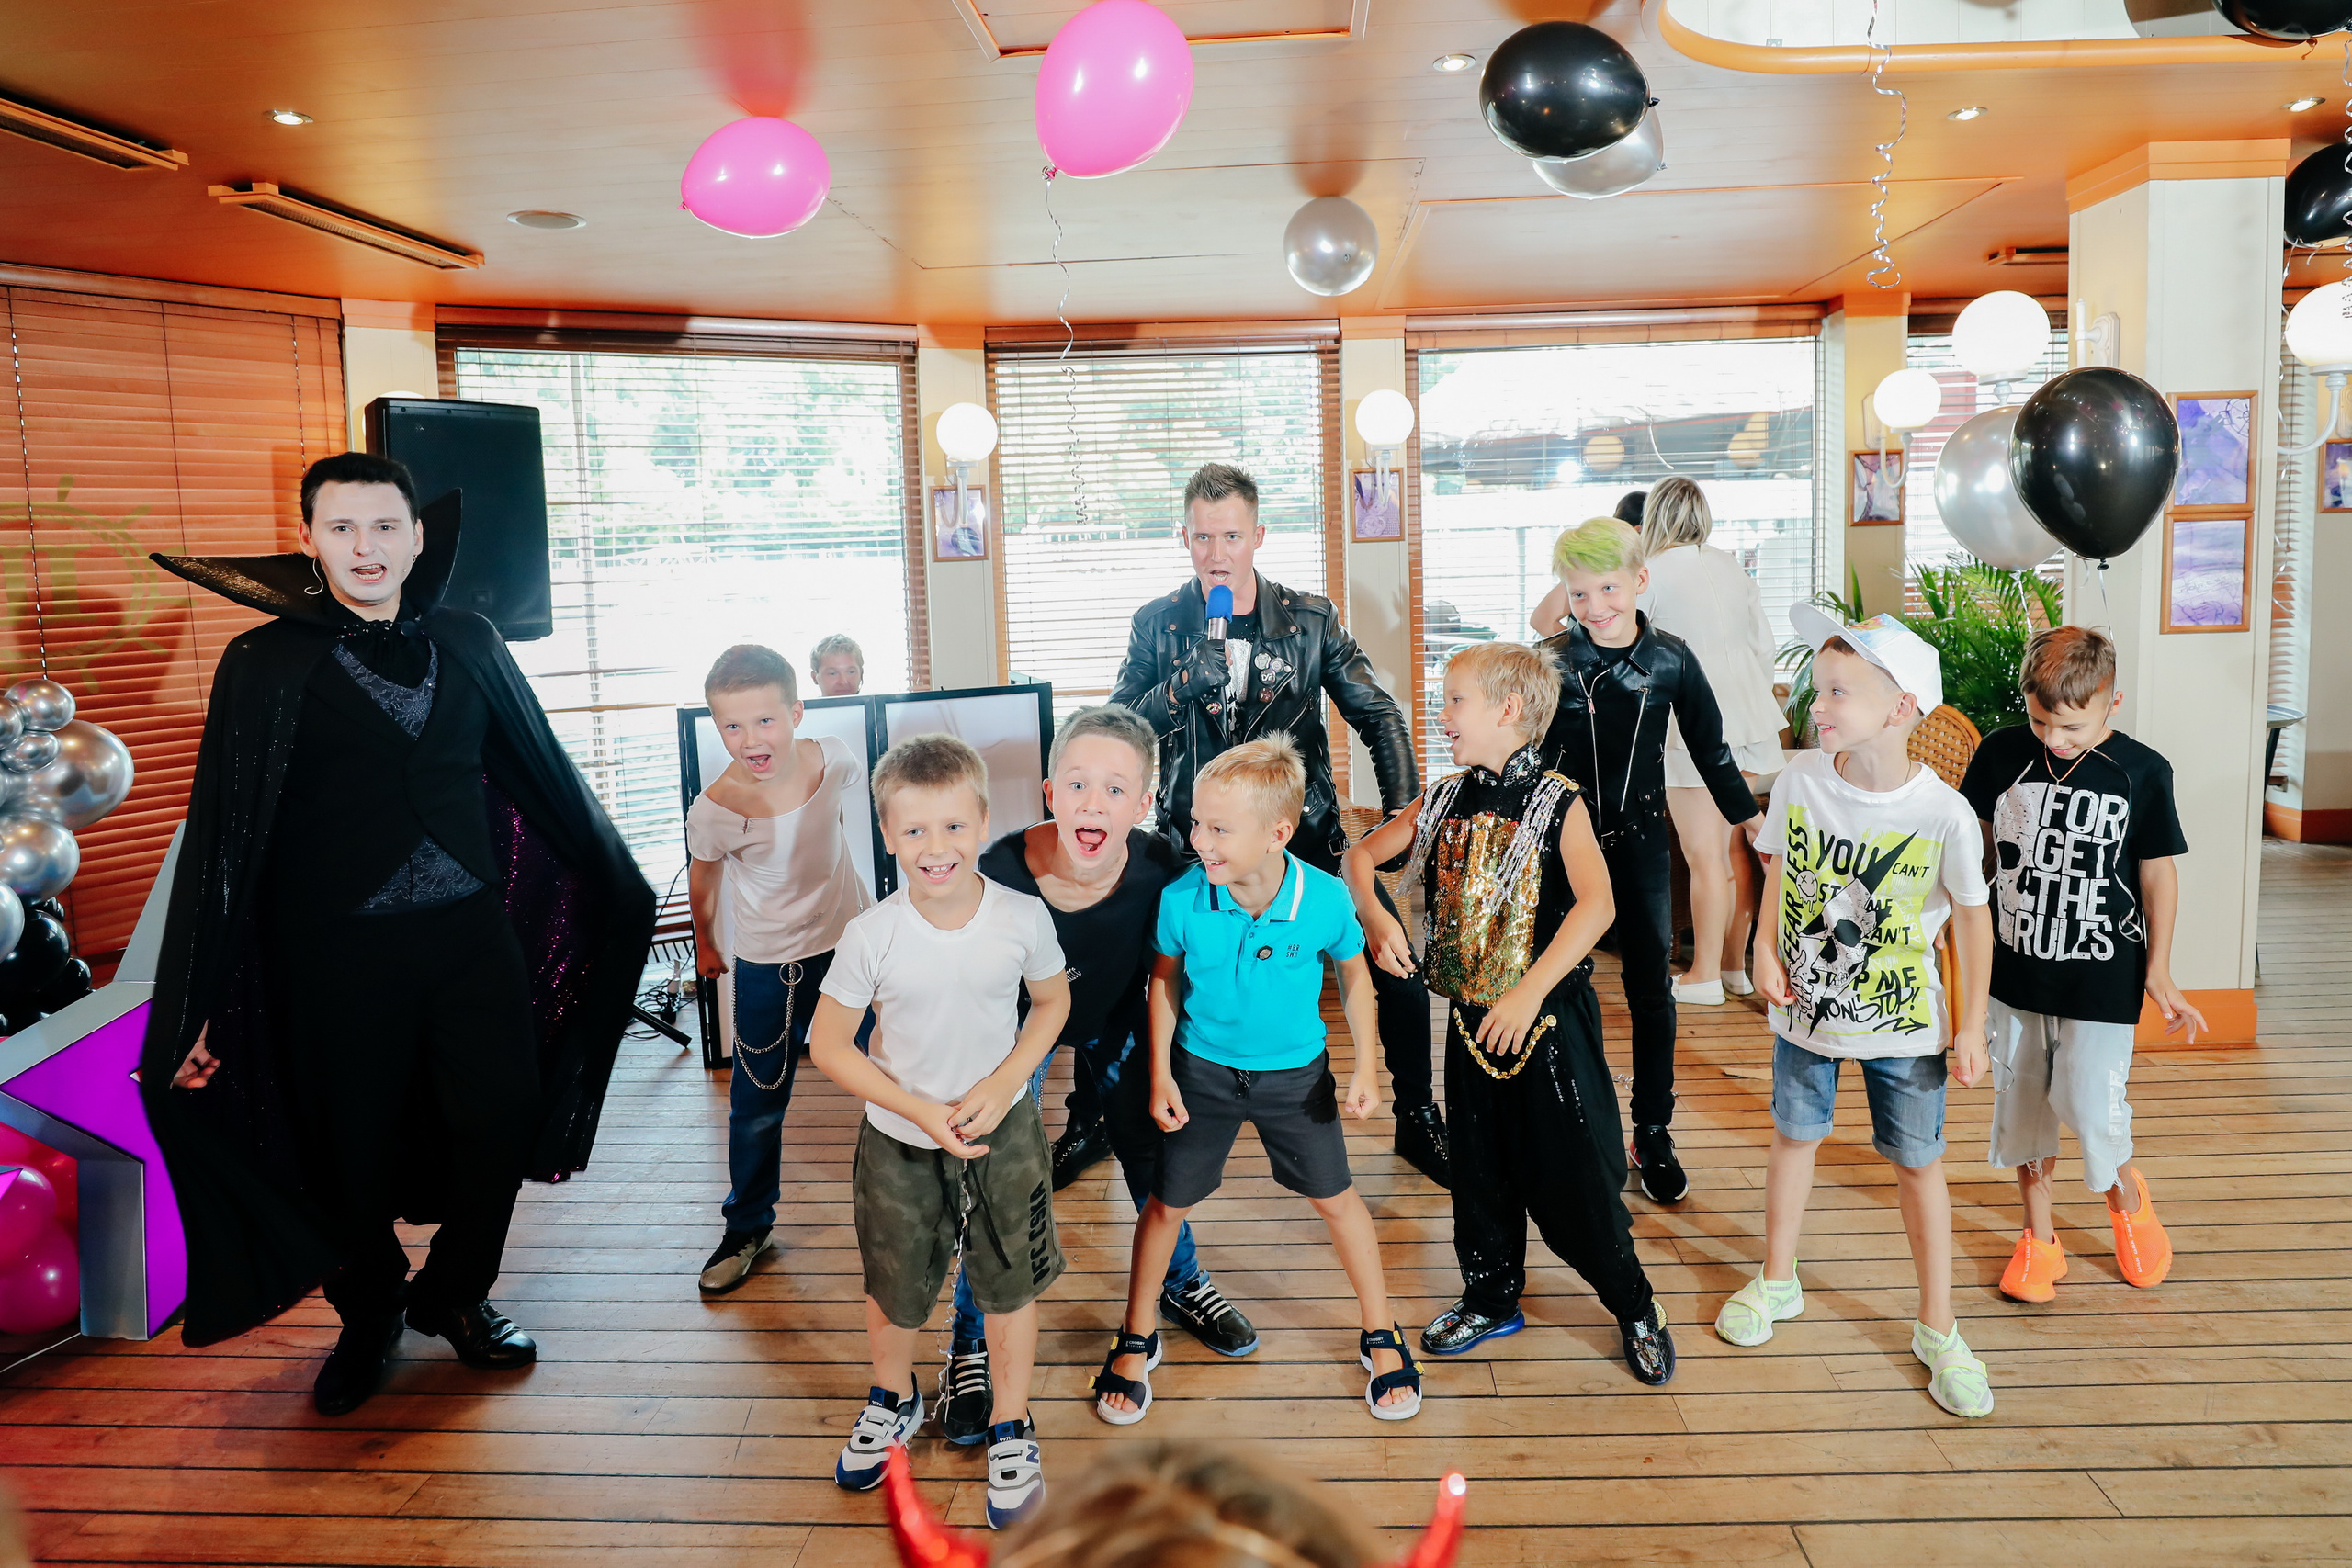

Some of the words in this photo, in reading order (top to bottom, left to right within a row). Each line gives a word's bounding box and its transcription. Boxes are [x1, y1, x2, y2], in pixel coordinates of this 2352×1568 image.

[2041, 784, 2130, 840] FOR
[1816, 830, 1880, 879] YOU
[1892, 862, 1930, 878] CAN'T
[2033, 828, 2117, 878] GET
[2032, 869, 2110, 922] THE
[2013, 909, 2115, 962] RULES
[1029, 1179, 1047, 1242] CSKA
